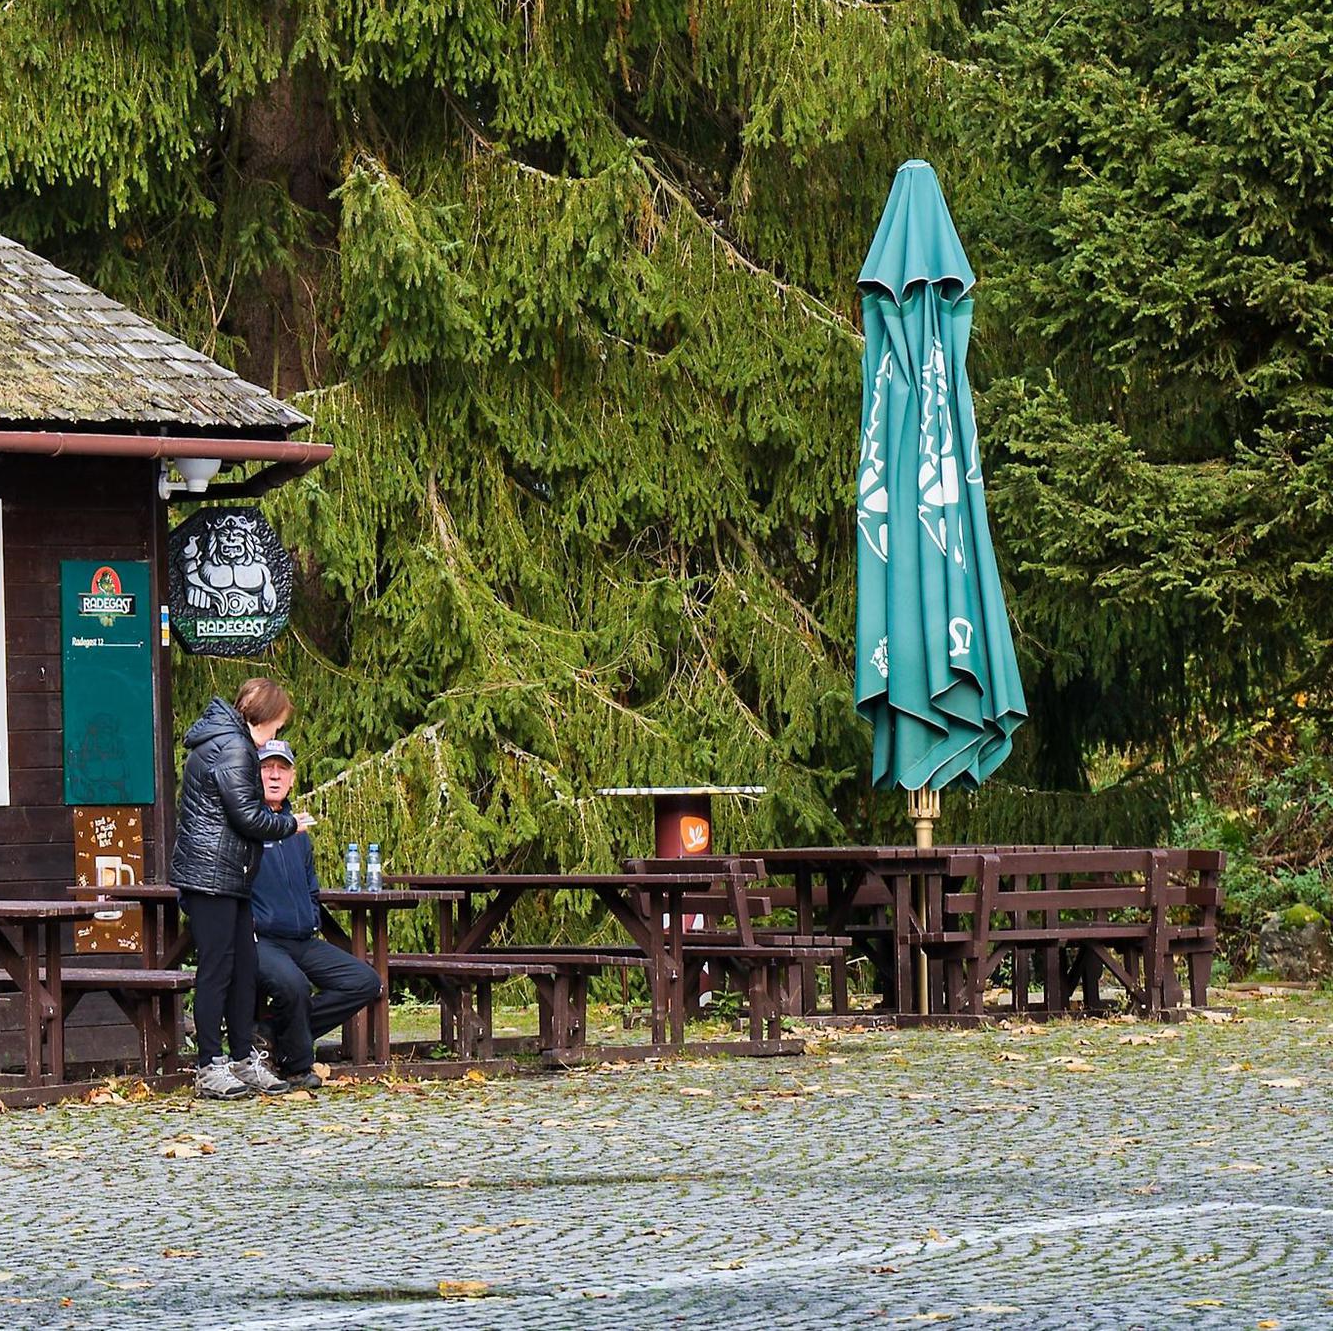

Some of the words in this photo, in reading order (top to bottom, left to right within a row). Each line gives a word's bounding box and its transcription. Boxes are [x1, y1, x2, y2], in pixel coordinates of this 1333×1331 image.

[83, 598, 132, 613] RADEGAST
[196, 619, 268, 637] RADEGAST
[71, 636, 97, 648] Radegast
